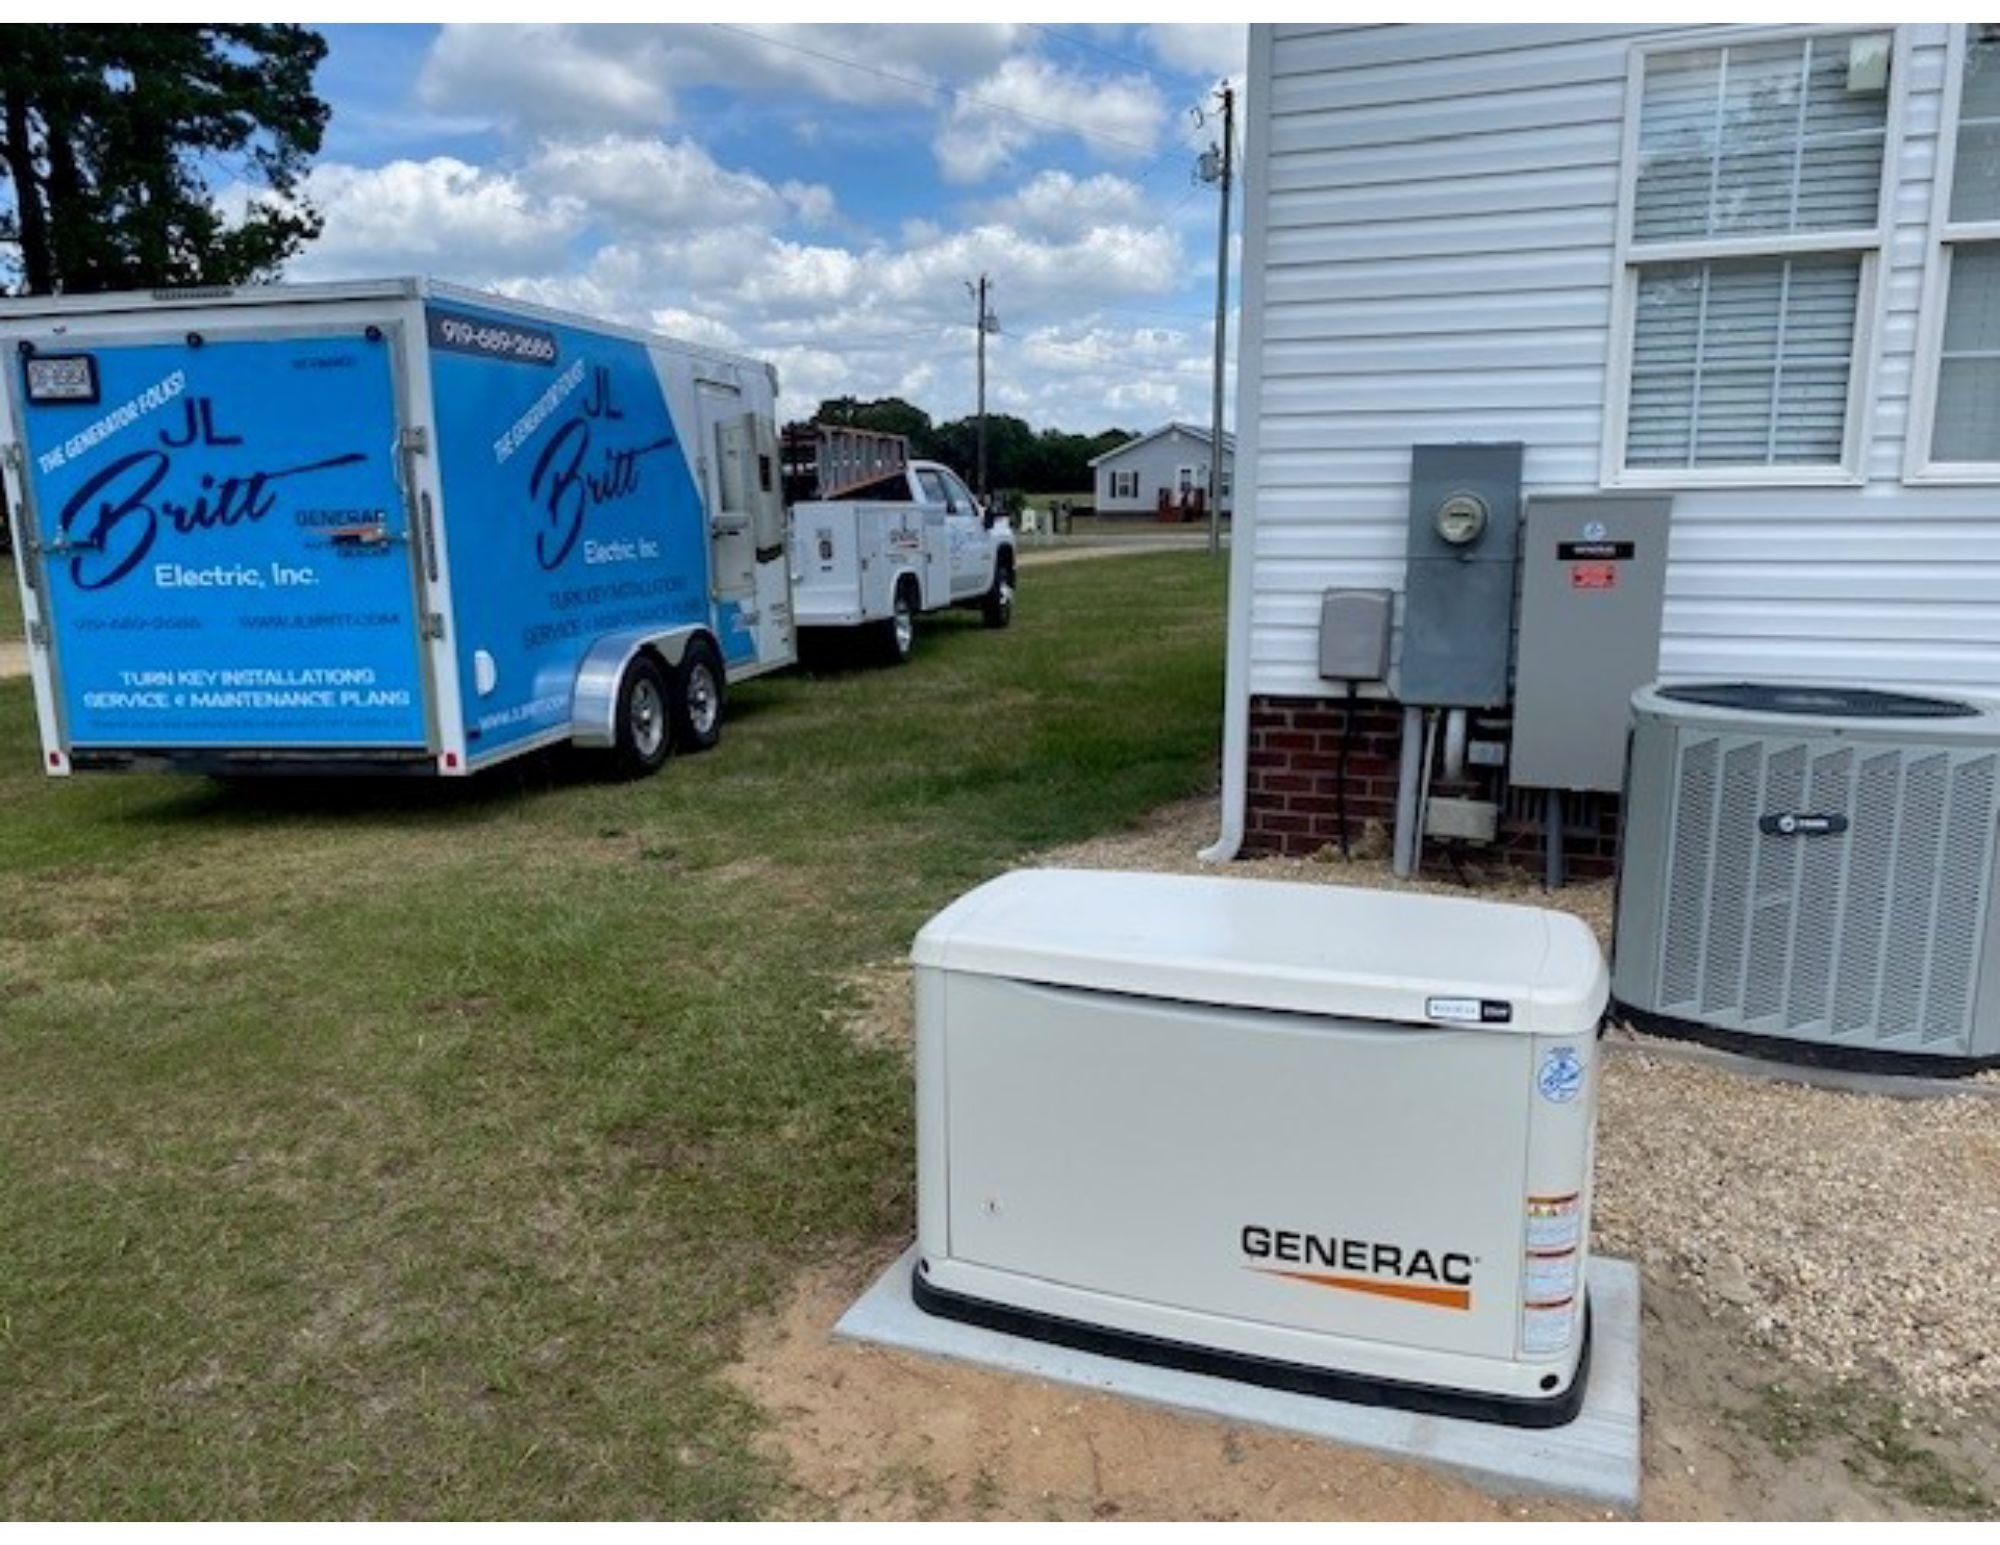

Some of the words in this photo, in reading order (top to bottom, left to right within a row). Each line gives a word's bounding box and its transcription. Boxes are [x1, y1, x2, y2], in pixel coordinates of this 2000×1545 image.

[583, 367, 624, 421] JL
[38, 446, 66, 474] THE
[64, 400, 139, 459] GENERATOR
[159, 397, 244, 448] JL
[61, 449, 368, 591] Britt
[530, 417, 676, 571] Britt
[154, 563, 267, 589] Electric,
[271, 562, 320, 586] Inc.
[83, 691, 170, 709] SERVICE
[189, 690, 336, 708] MAINTENANCE
[117, 670, 174, 687] TURN
[176, 669, 219, 687] KEY
[220, 668, 376, 687] INSTALLATIONS
[1241, 1224, 1473, 1285] GENERAC
